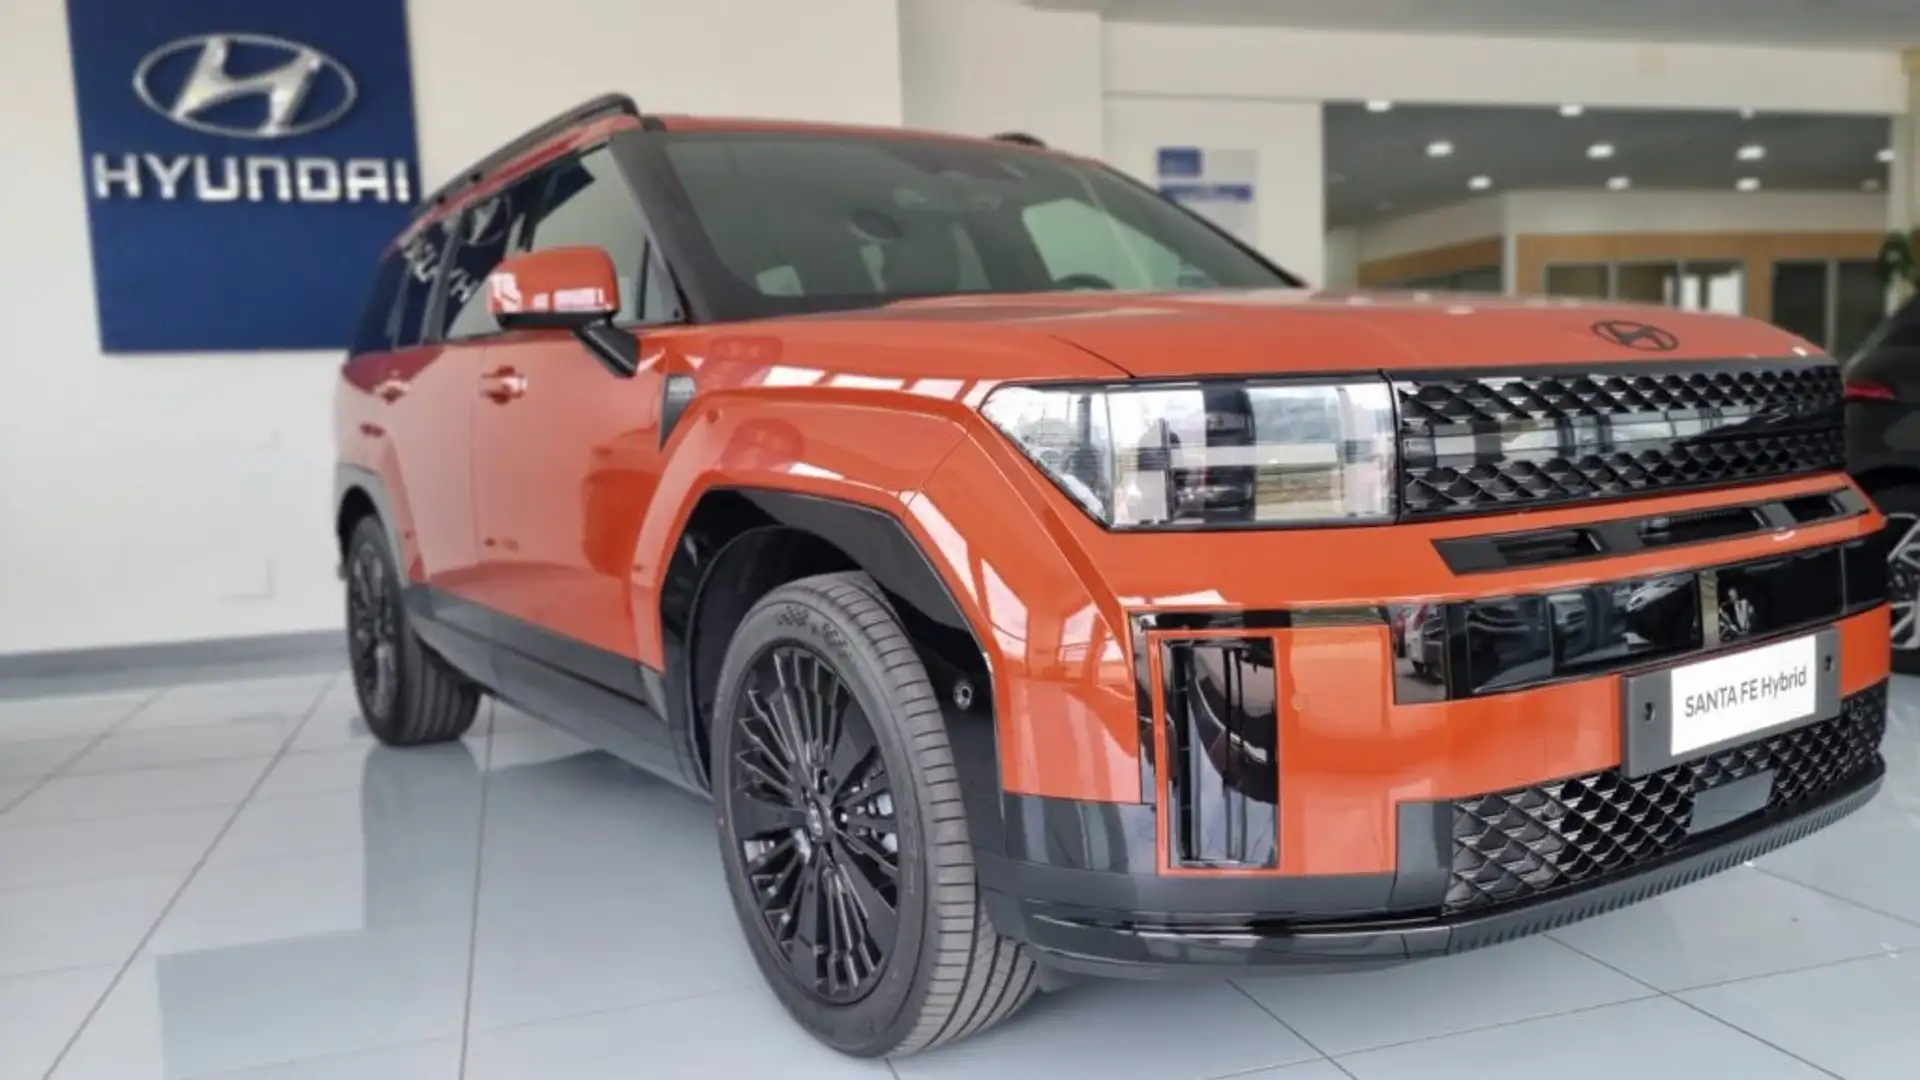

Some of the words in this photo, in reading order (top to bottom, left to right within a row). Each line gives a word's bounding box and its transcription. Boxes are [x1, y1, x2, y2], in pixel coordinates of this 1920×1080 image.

[93, 153, 410, 202] HYUNDAI
[1685, 685, 1738, 718] SANTA
[1740, 678, 1758, 704] FE
[1761, 665, 1807, 699] Hybrid
